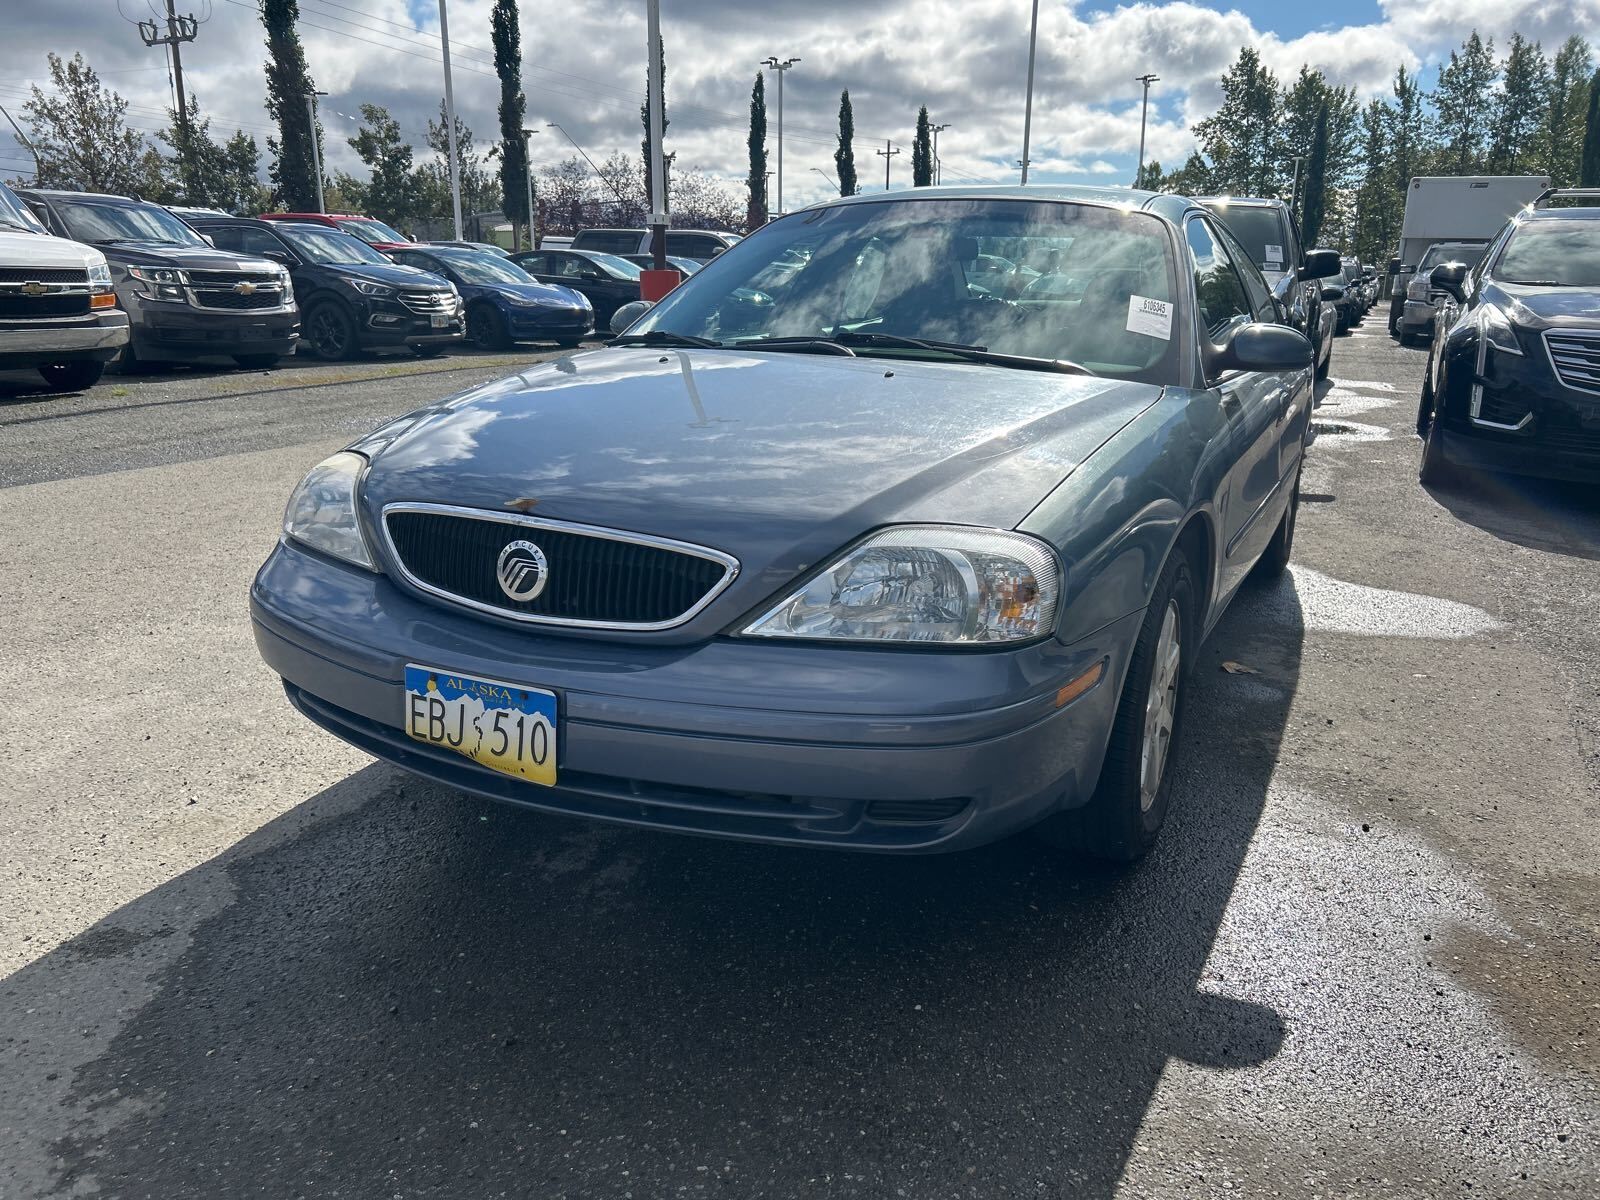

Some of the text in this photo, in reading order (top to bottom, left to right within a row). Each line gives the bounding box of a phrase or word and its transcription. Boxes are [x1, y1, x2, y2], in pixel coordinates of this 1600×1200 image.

[1143, 299, 1166, 314] 6106345
[502, 541, 543, 561] MERCURY
[411, 693, 548, 766] EBJ 510
